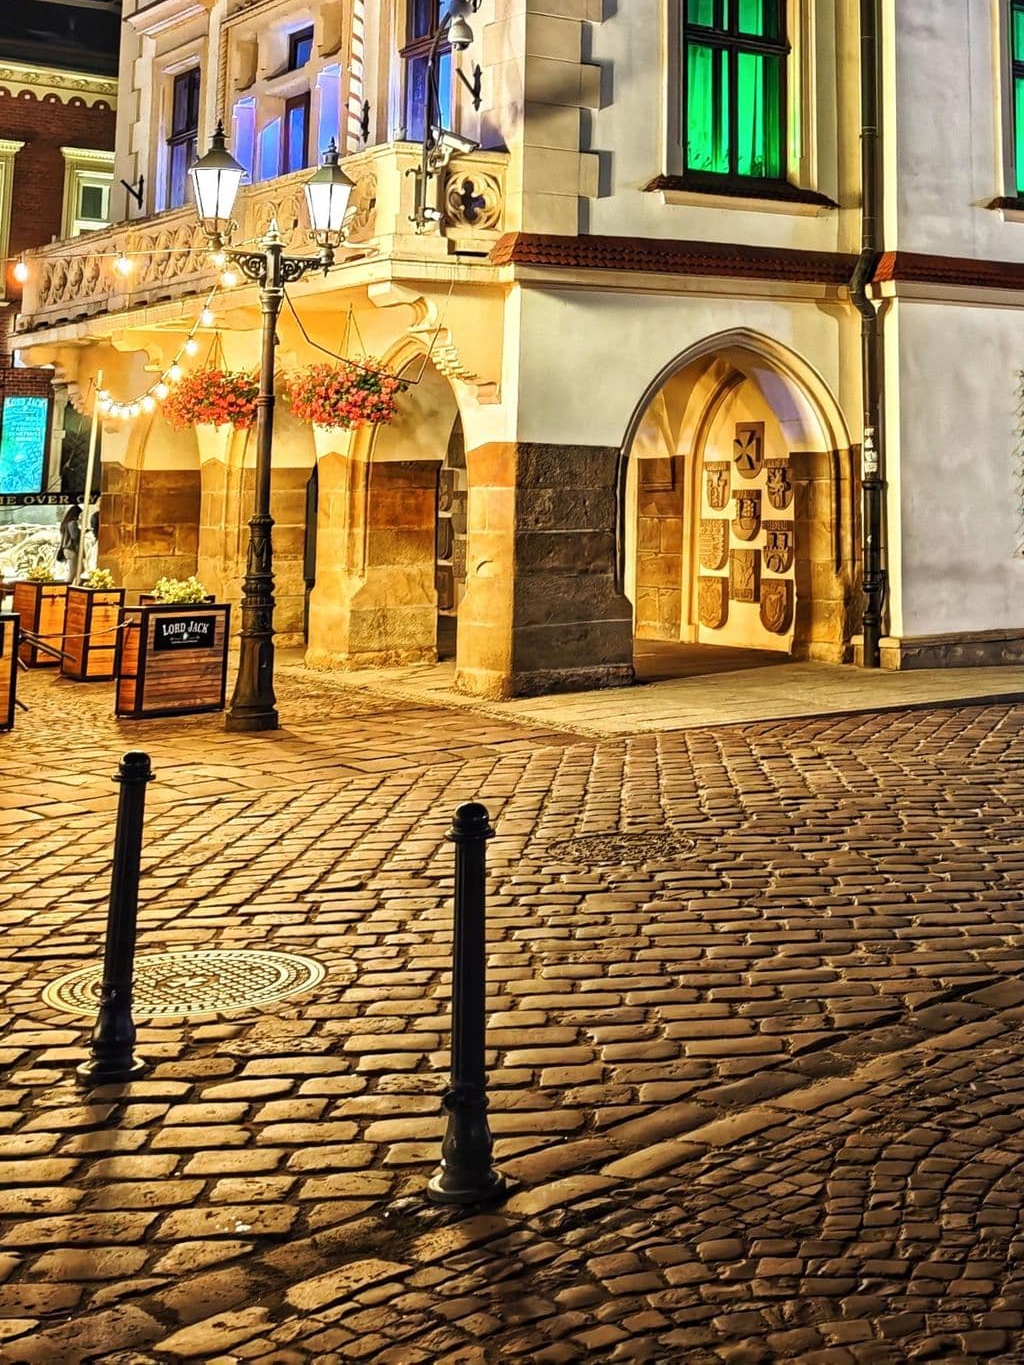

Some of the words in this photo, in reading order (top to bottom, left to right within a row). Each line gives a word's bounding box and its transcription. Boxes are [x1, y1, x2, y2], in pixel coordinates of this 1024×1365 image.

[23, 495, 70, 505] OVER
[162, 622, 187, 637] LORD
[188, 620, 210, 634] JACK
